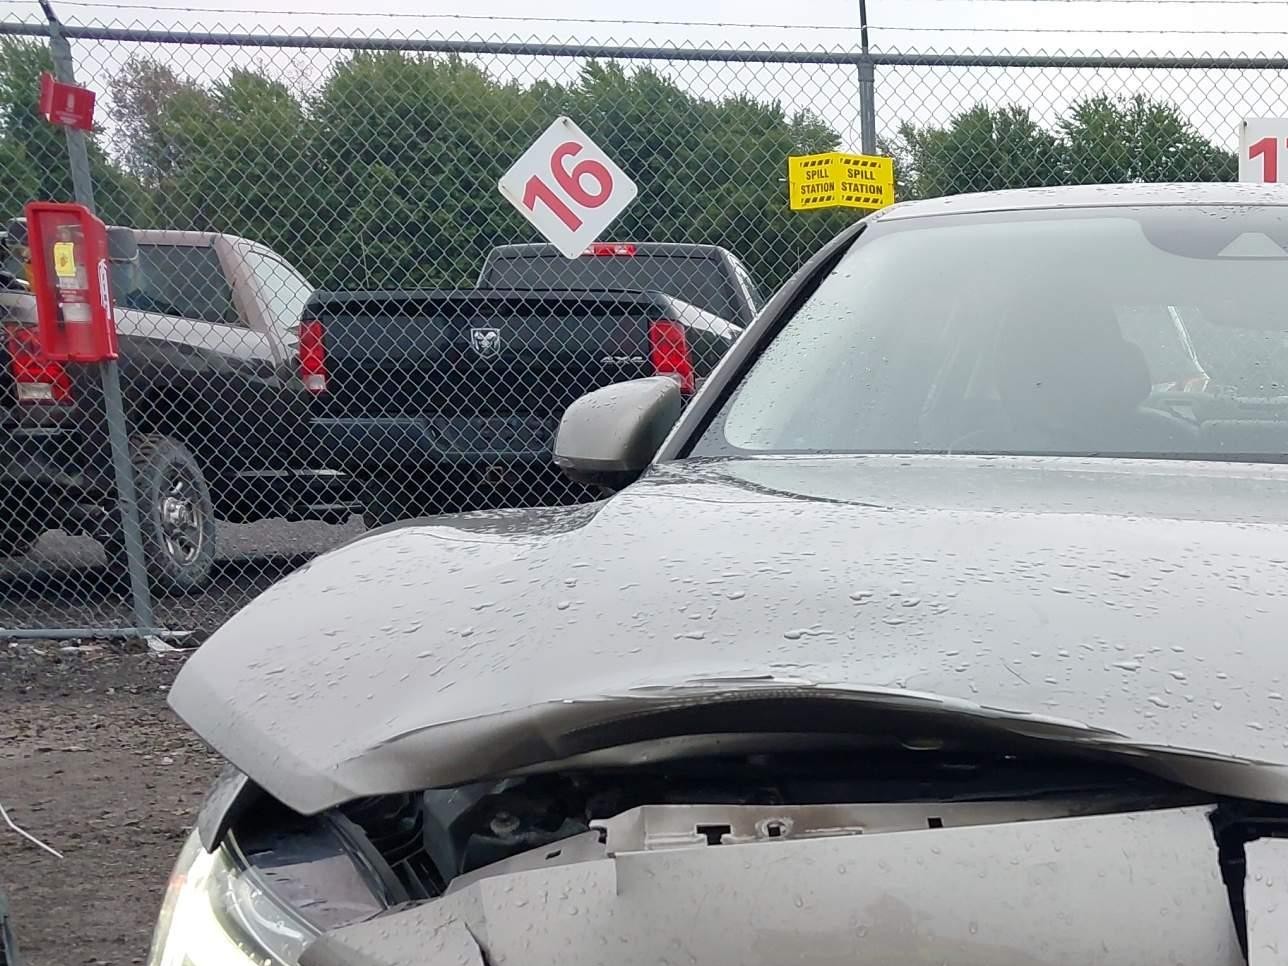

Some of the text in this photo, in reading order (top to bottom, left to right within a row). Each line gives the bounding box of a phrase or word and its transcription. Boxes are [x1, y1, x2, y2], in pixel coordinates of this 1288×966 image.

[806, 169, 829, 180] SPILL
[847, 168, 875, 180] SPILL
[522, 141, 613, 232] 16
[800, 182, 835, 195] STATION
[841, 181, 883, 195] STATION
